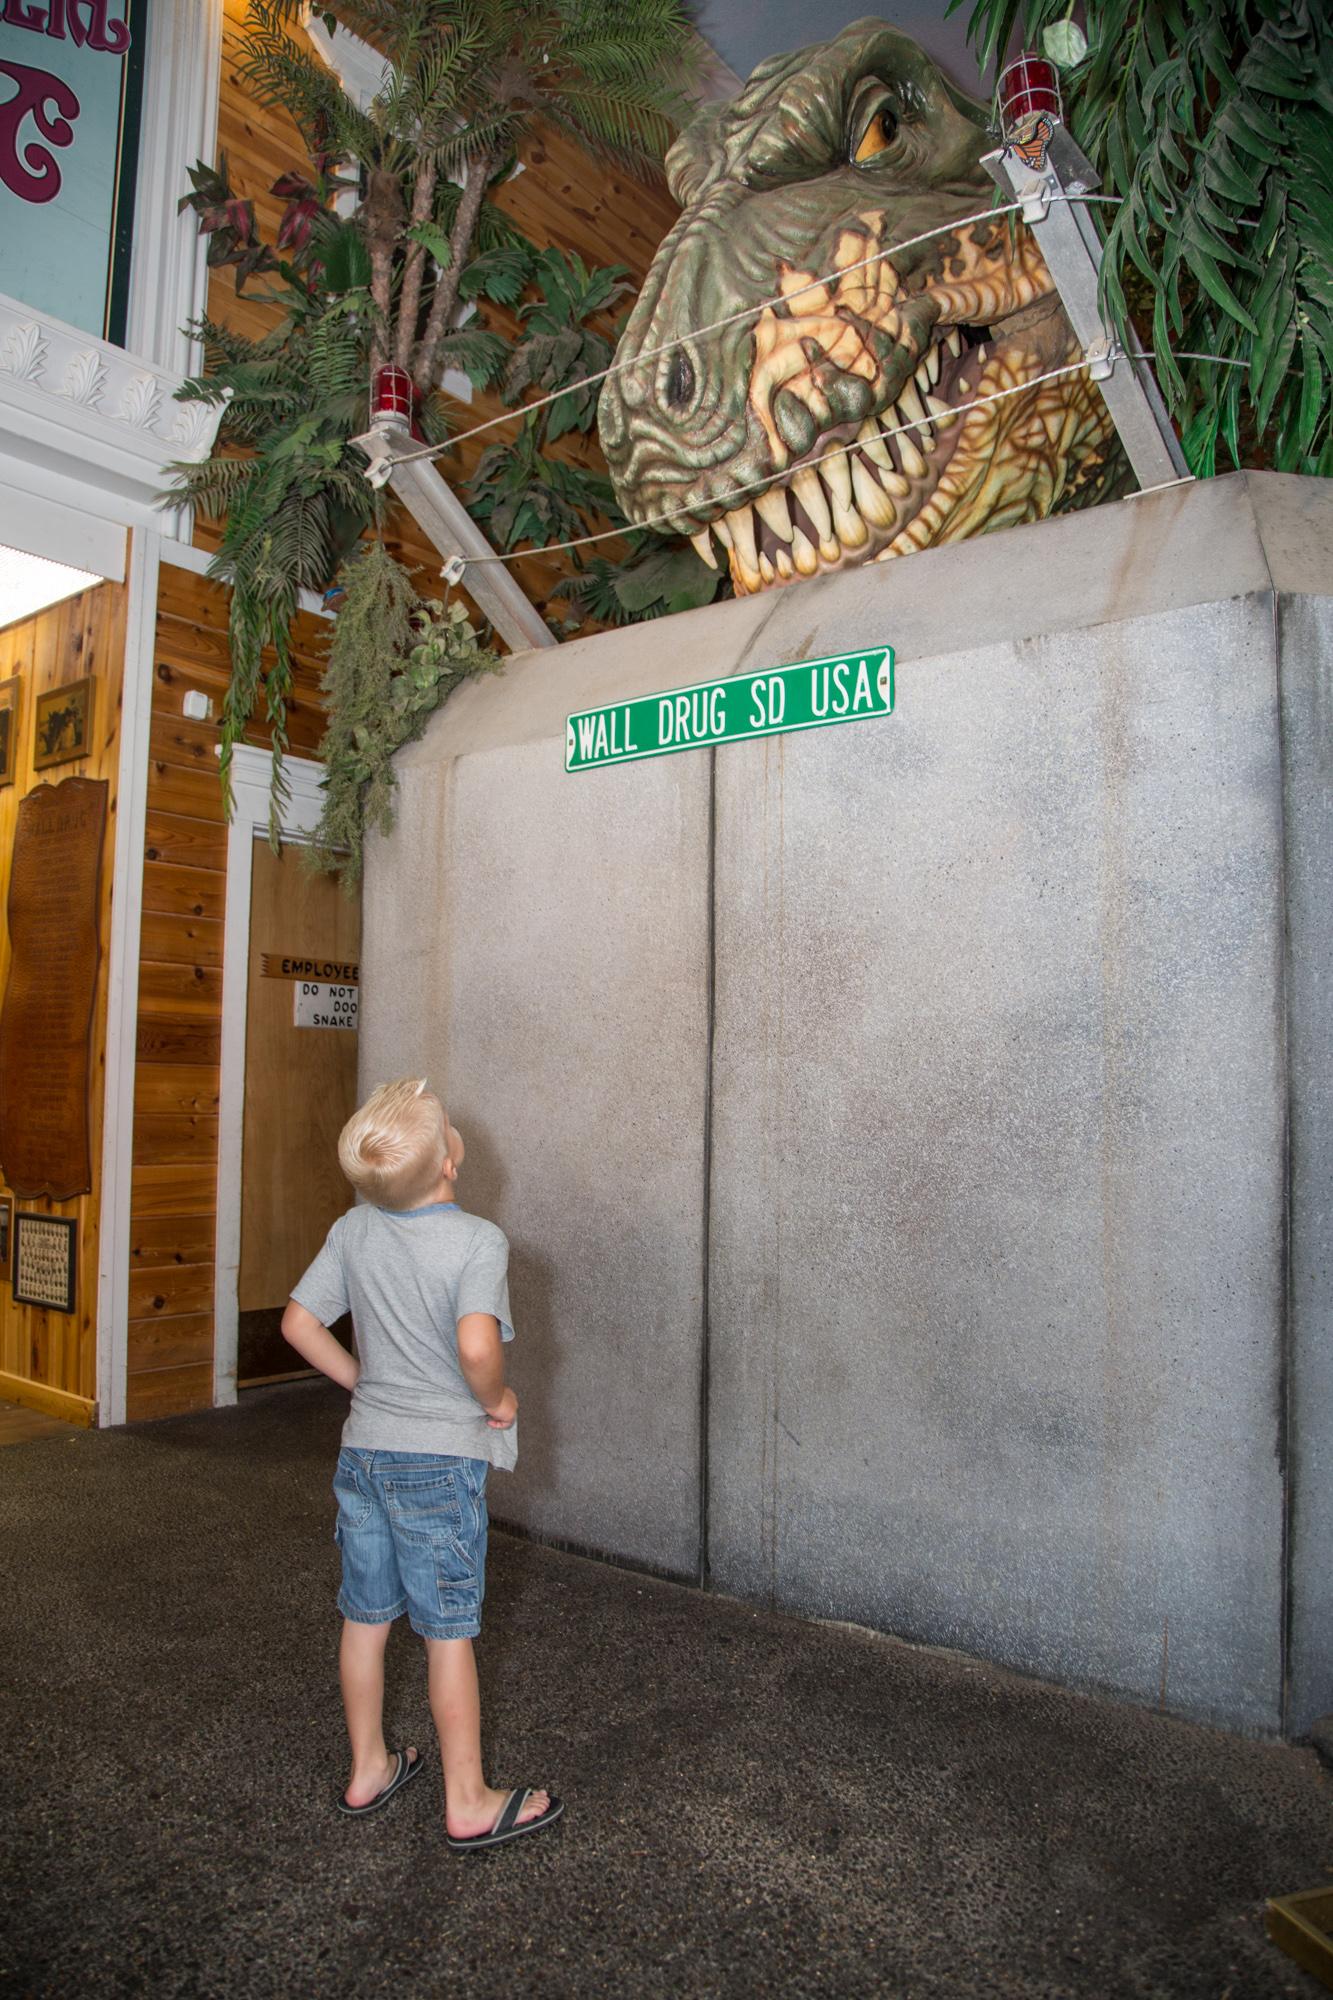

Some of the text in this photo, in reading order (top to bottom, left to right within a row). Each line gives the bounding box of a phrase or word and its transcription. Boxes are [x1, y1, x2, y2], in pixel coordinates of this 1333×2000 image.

[577, 660, 874, 761] WALL DRUG SD USA
[281, 959, 359, 980] EMPLOYEE
[302, 983, 355, 999] DO NOT
[313, 1014, 353, 1028] SNAKE
